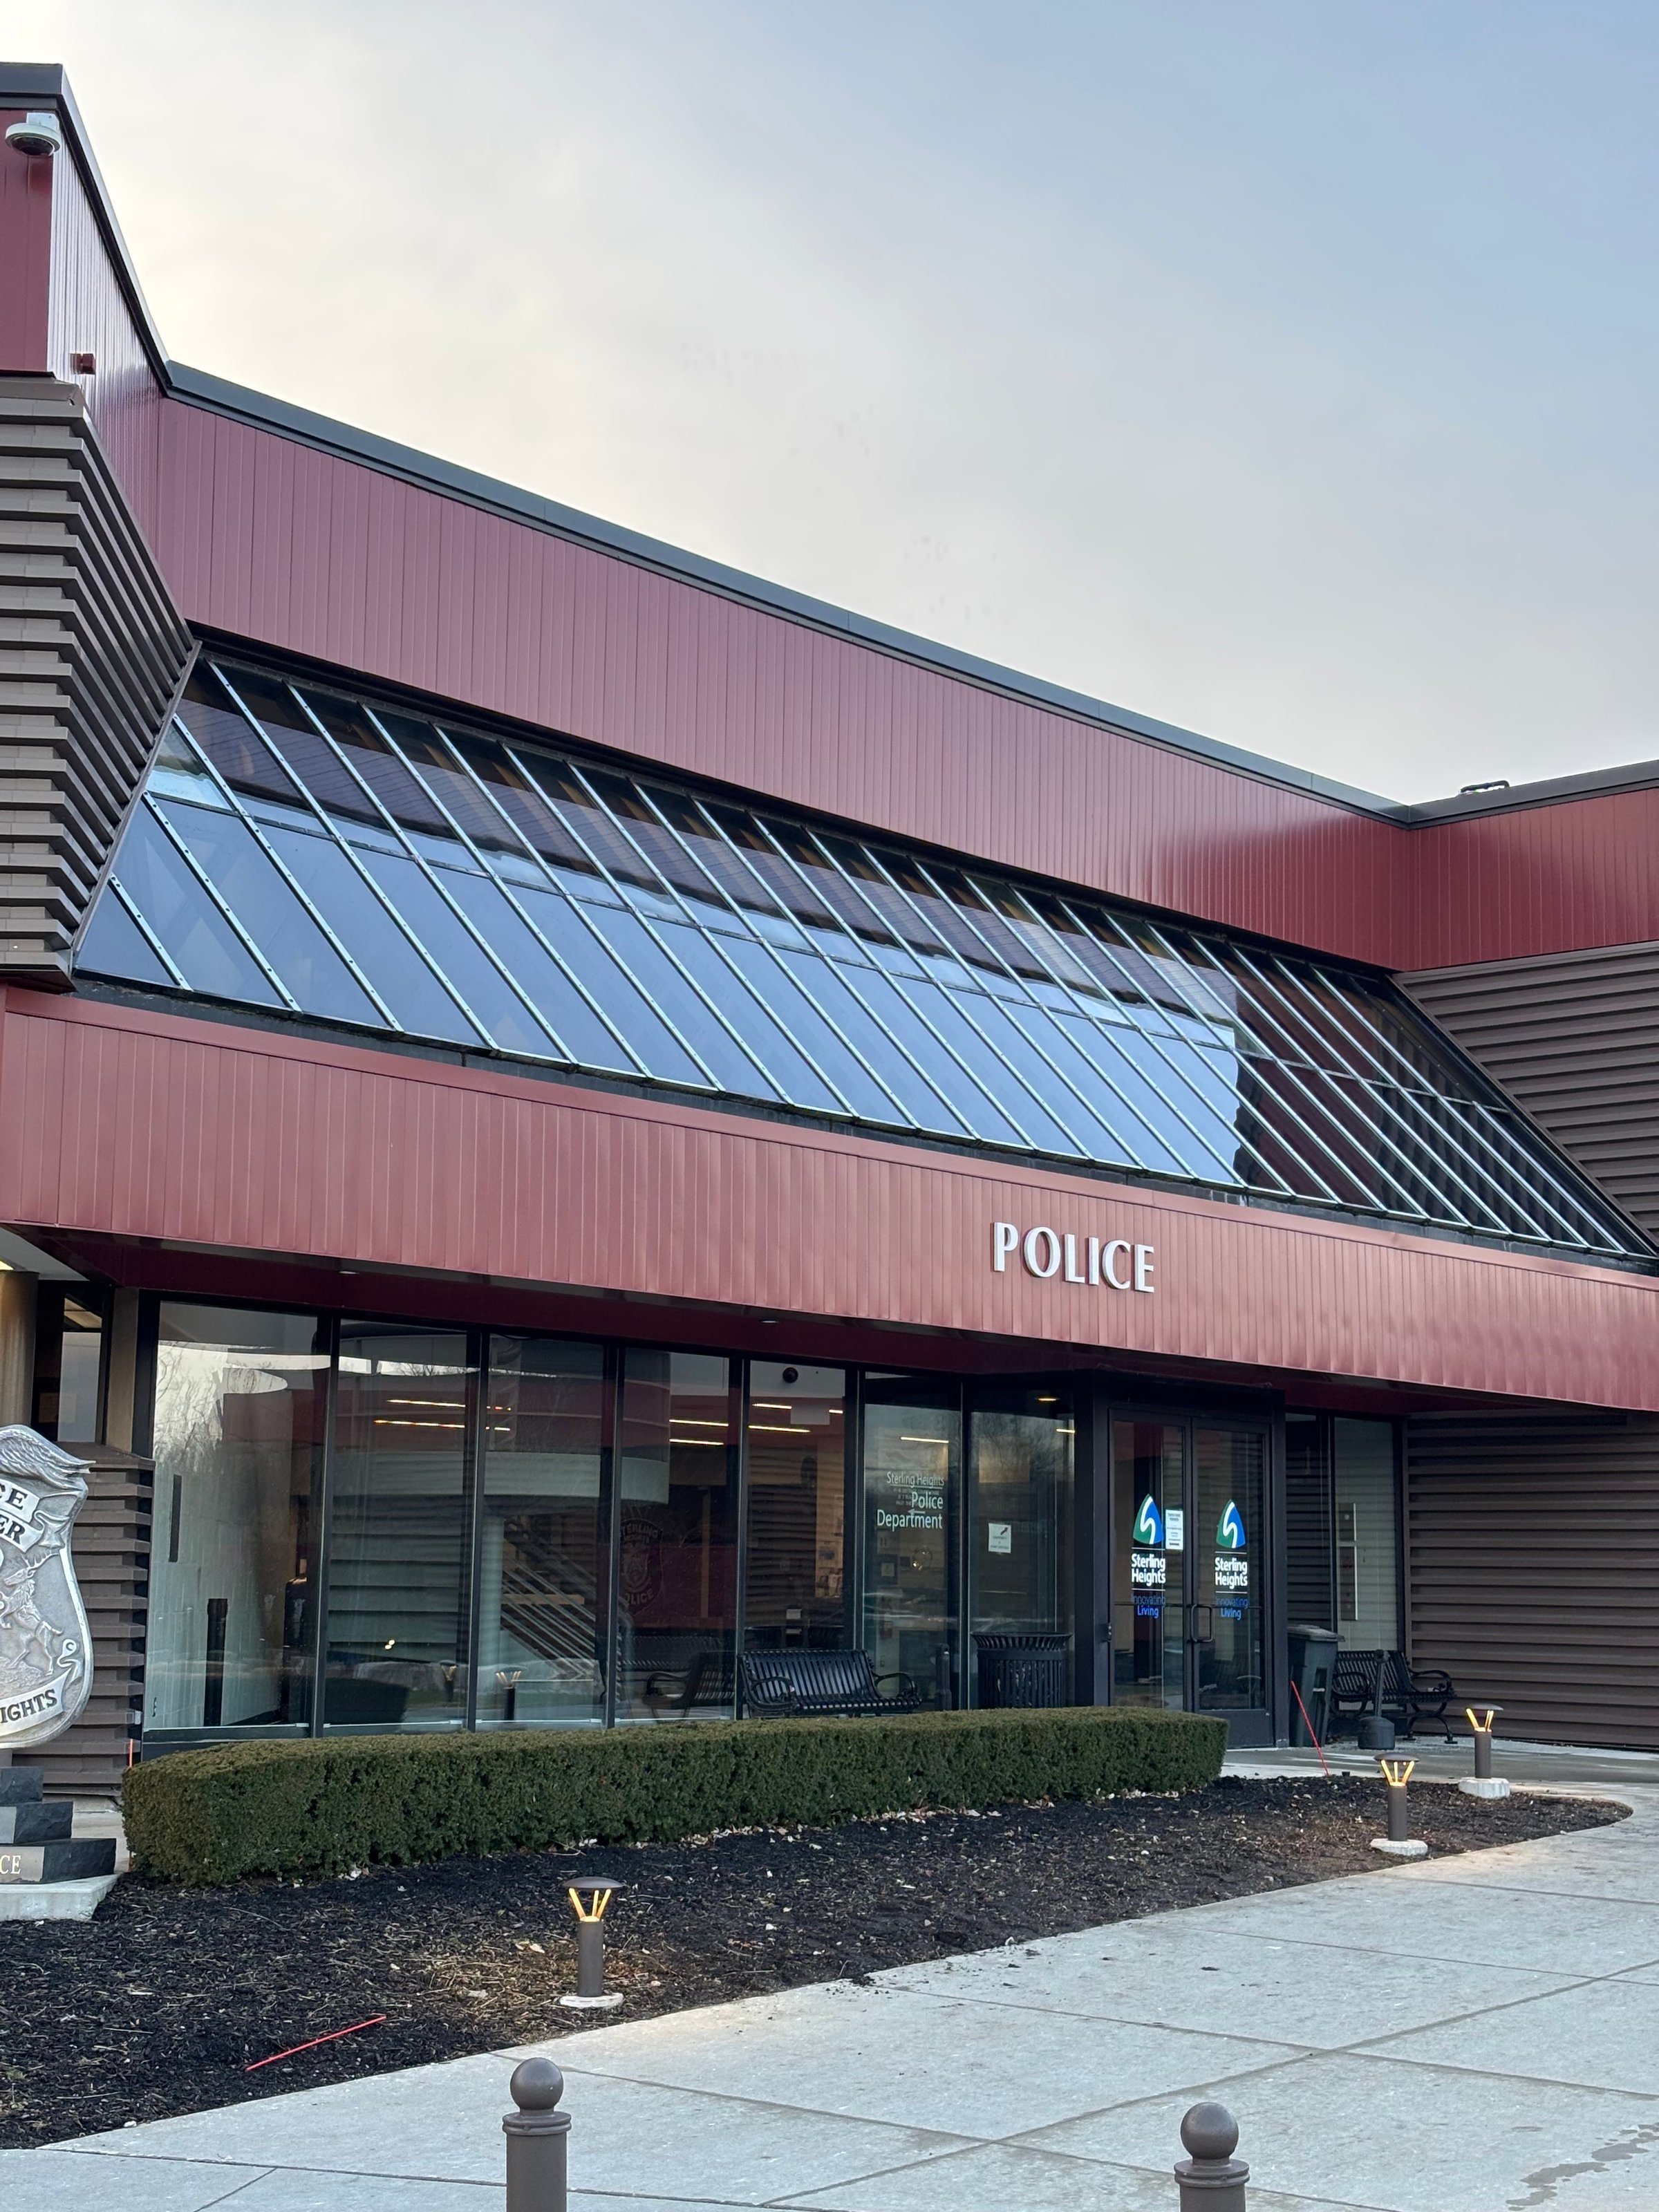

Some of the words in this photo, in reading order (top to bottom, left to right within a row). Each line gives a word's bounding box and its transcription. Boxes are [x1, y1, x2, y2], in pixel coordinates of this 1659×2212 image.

[993, 1221, 1154, 1293] POLICE
[887, 1471, 915, 1488] Sterling
[917, 1472, 944, 1489] Heights
[911, 1491, 944, 1509] Police
[877, 1508, 943, 1533] Department
[1131, 1553, 1166, 1573] Sterling
[1215, 1557, 1248, 1575] Sterling
[1131, 1568, 1166, 1586] Heights
[1215, 1571, 1248, 1589] Heights
[1131, 1593, 1166, 1608] Innovating
[1137, 1604, 1159, 1619] Living
[1220, 1607, 1242, 1620] Living
